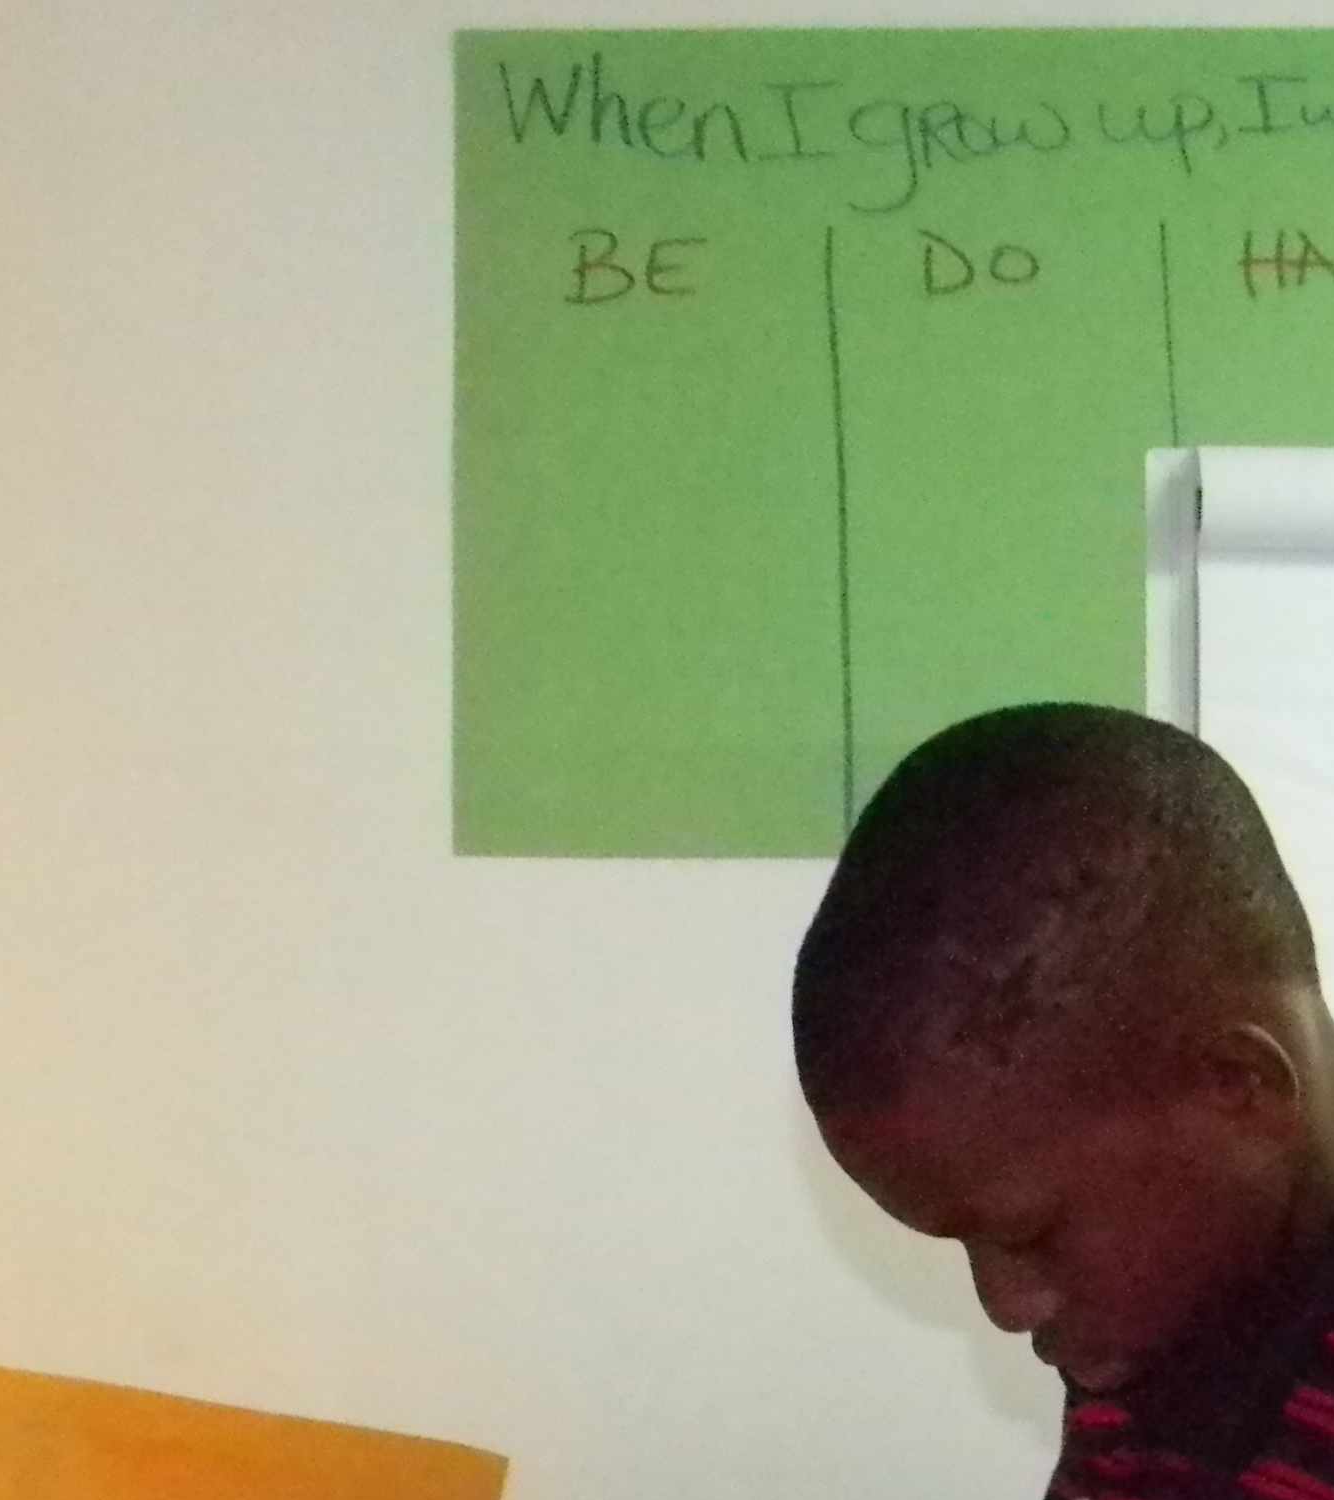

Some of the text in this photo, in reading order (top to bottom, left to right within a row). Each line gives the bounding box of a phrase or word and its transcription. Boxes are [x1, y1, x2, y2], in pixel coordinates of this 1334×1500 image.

[498, 52, 751, 166] When
[758, 80, 843, 165] I
[1236, 75, 1308, 134] I
[563, 229, 707, 304] BE
[918, 228, 1041, 298] DO
